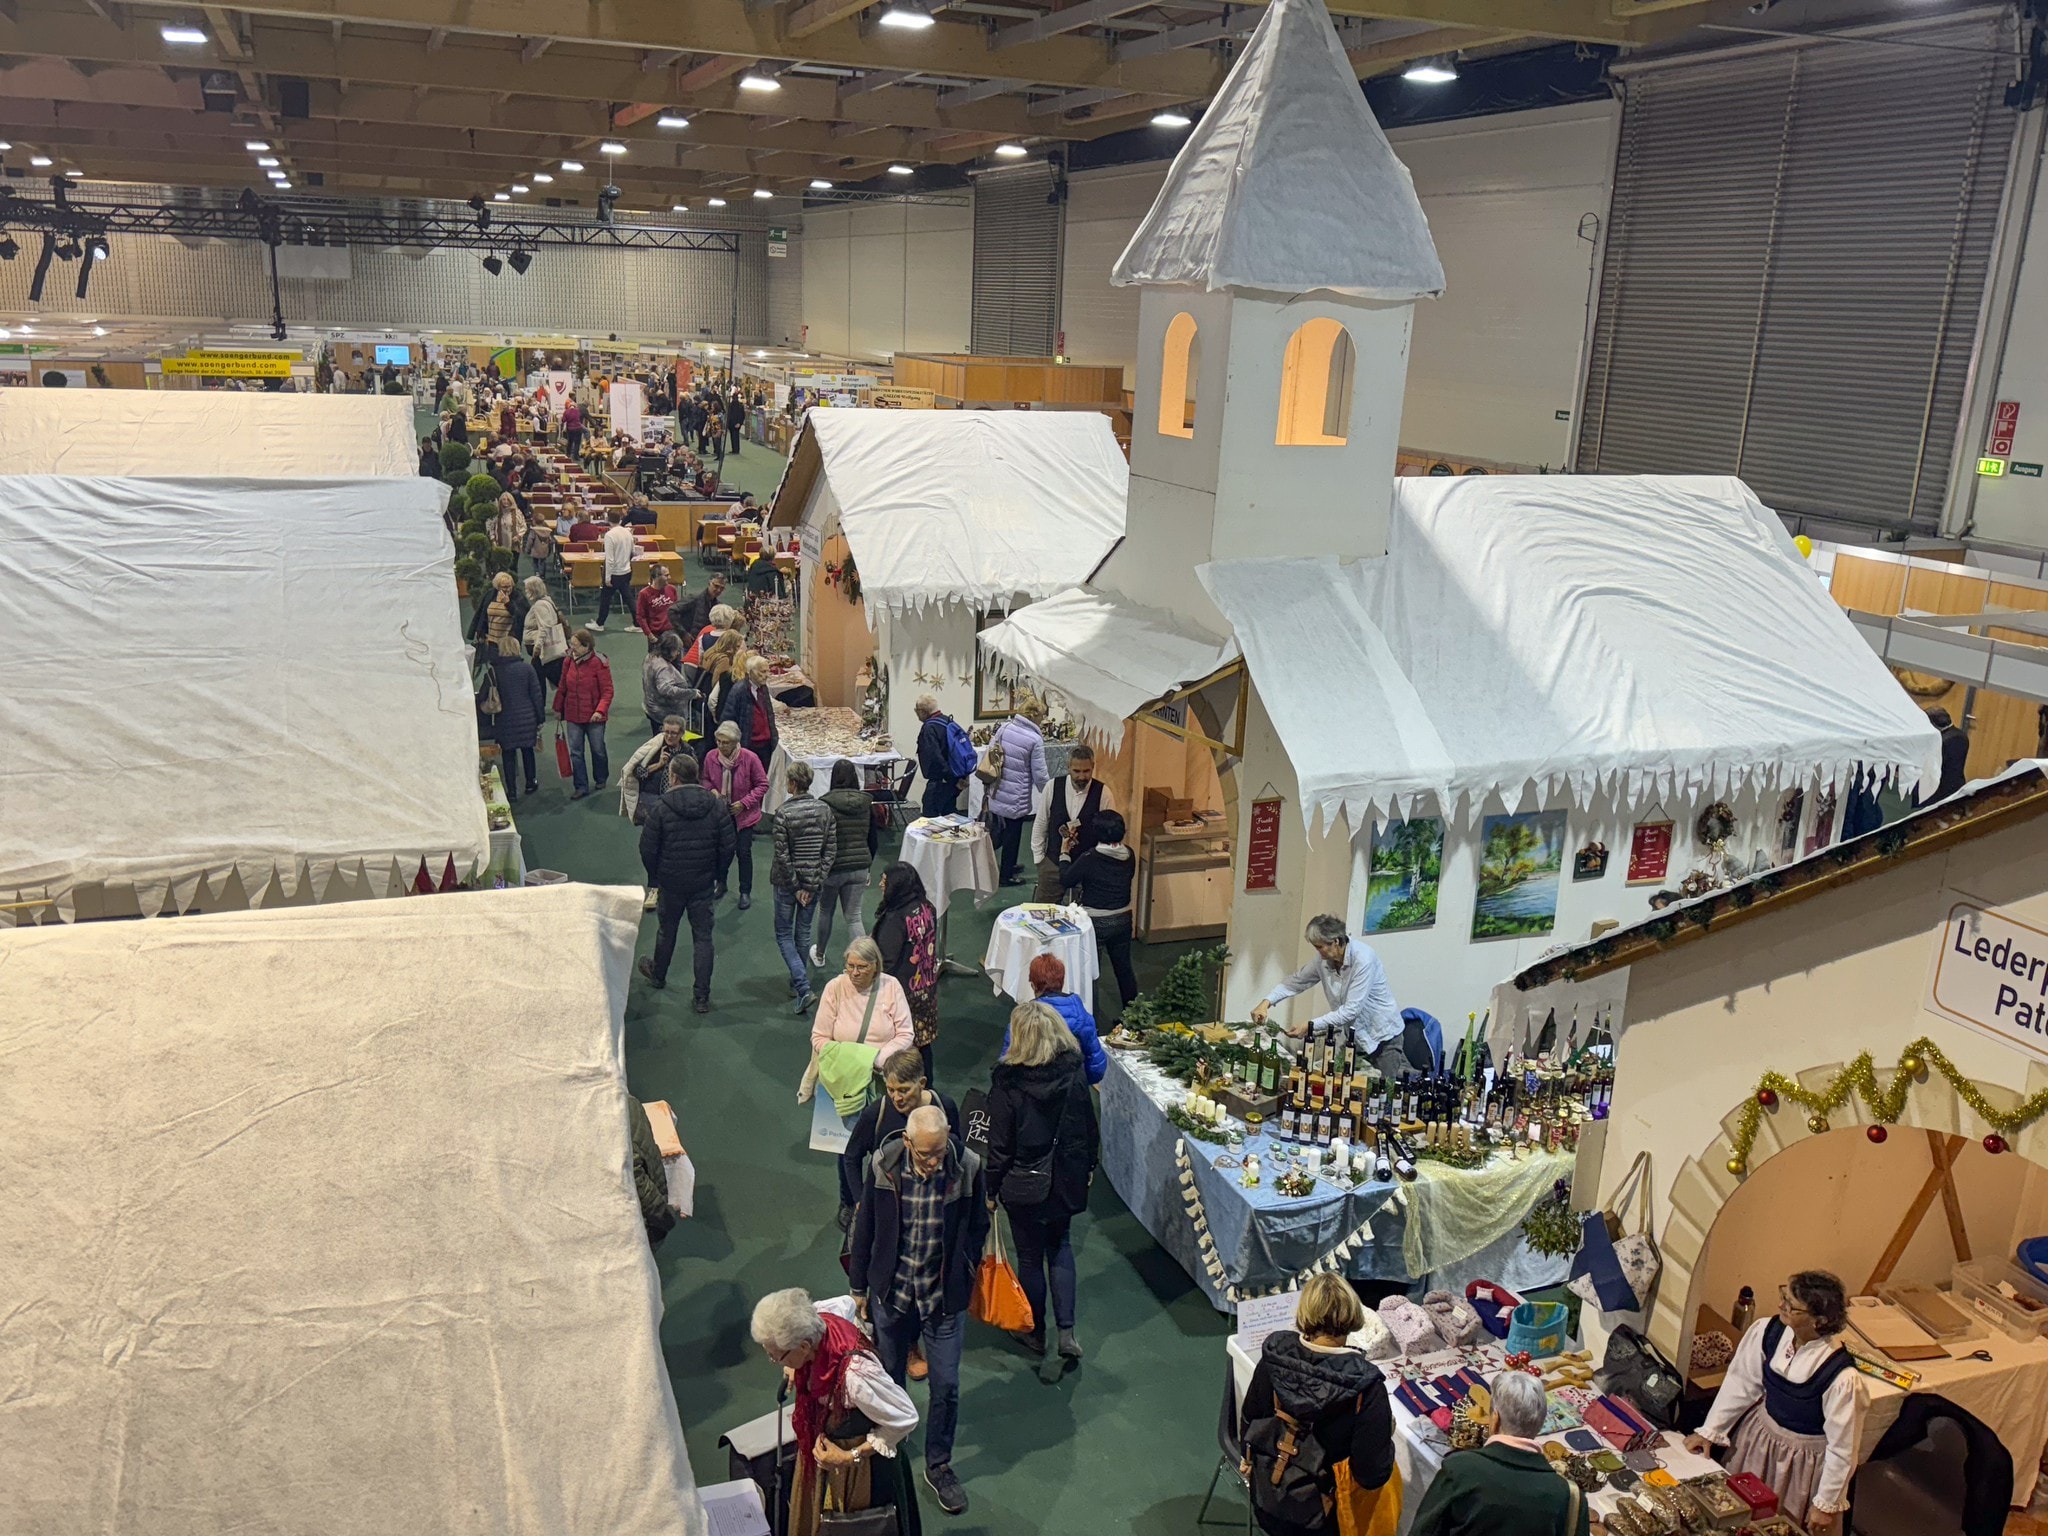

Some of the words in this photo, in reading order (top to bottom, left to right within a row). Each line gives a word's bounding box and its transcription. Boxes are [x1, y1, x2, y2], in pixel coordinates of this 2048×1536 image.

[199, 352, 290, 360] www.saengerbund.com
[176, 361, 277, 369] www.saengerbund.com
[2013, 464, 2039, 476] Ausgang
[1994, 984, 2048, 1038] Pat
